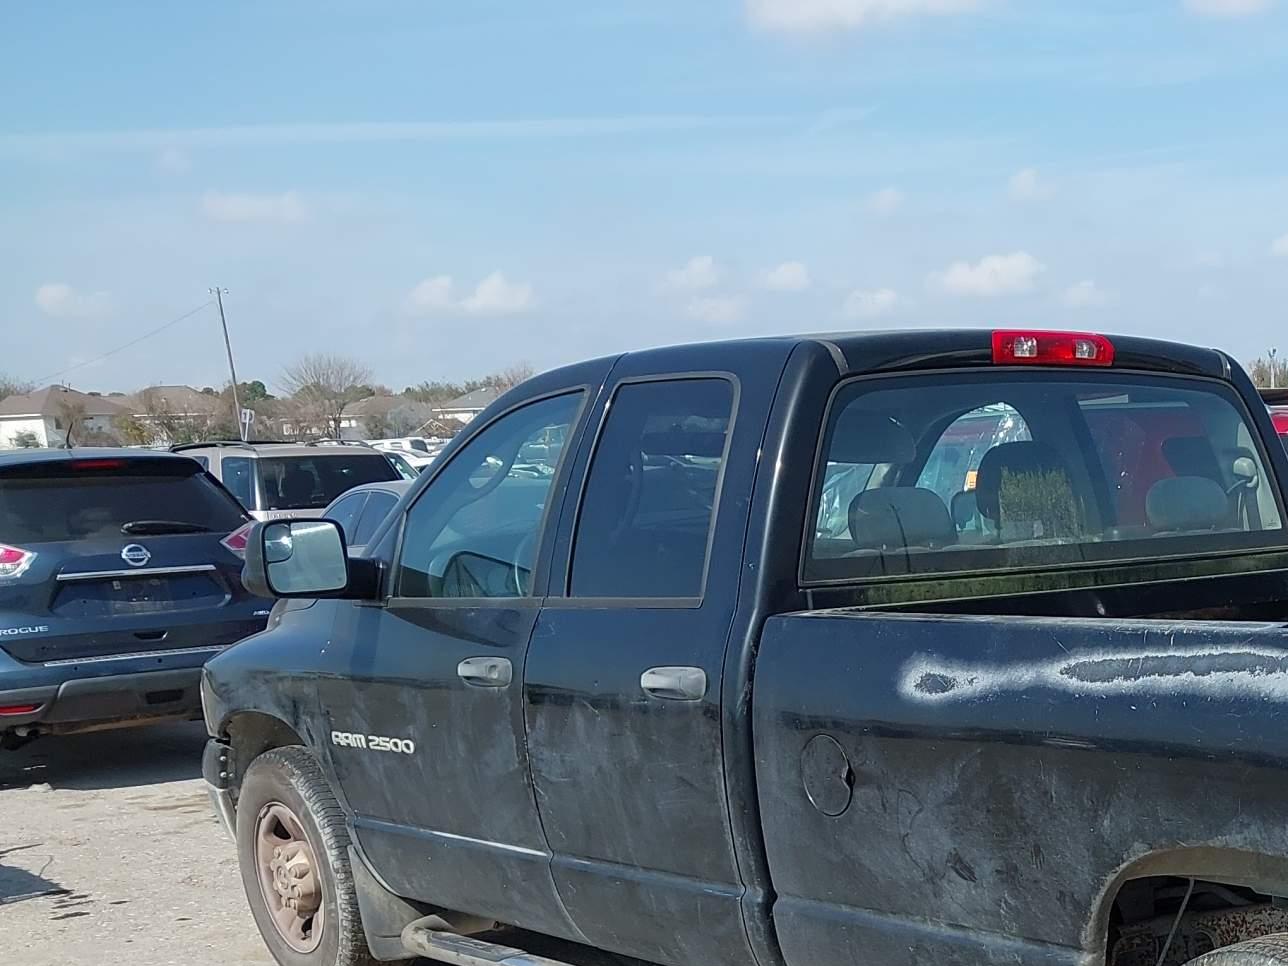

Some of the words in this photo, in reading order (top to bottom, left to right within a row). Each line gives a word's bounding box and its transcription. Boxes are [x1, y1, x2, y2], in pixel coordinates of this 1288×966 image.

[0, 625, 49, 636] ROGUE
[331, 730, 367, 749] RAM
[367, 735, 415, 754] 2500
